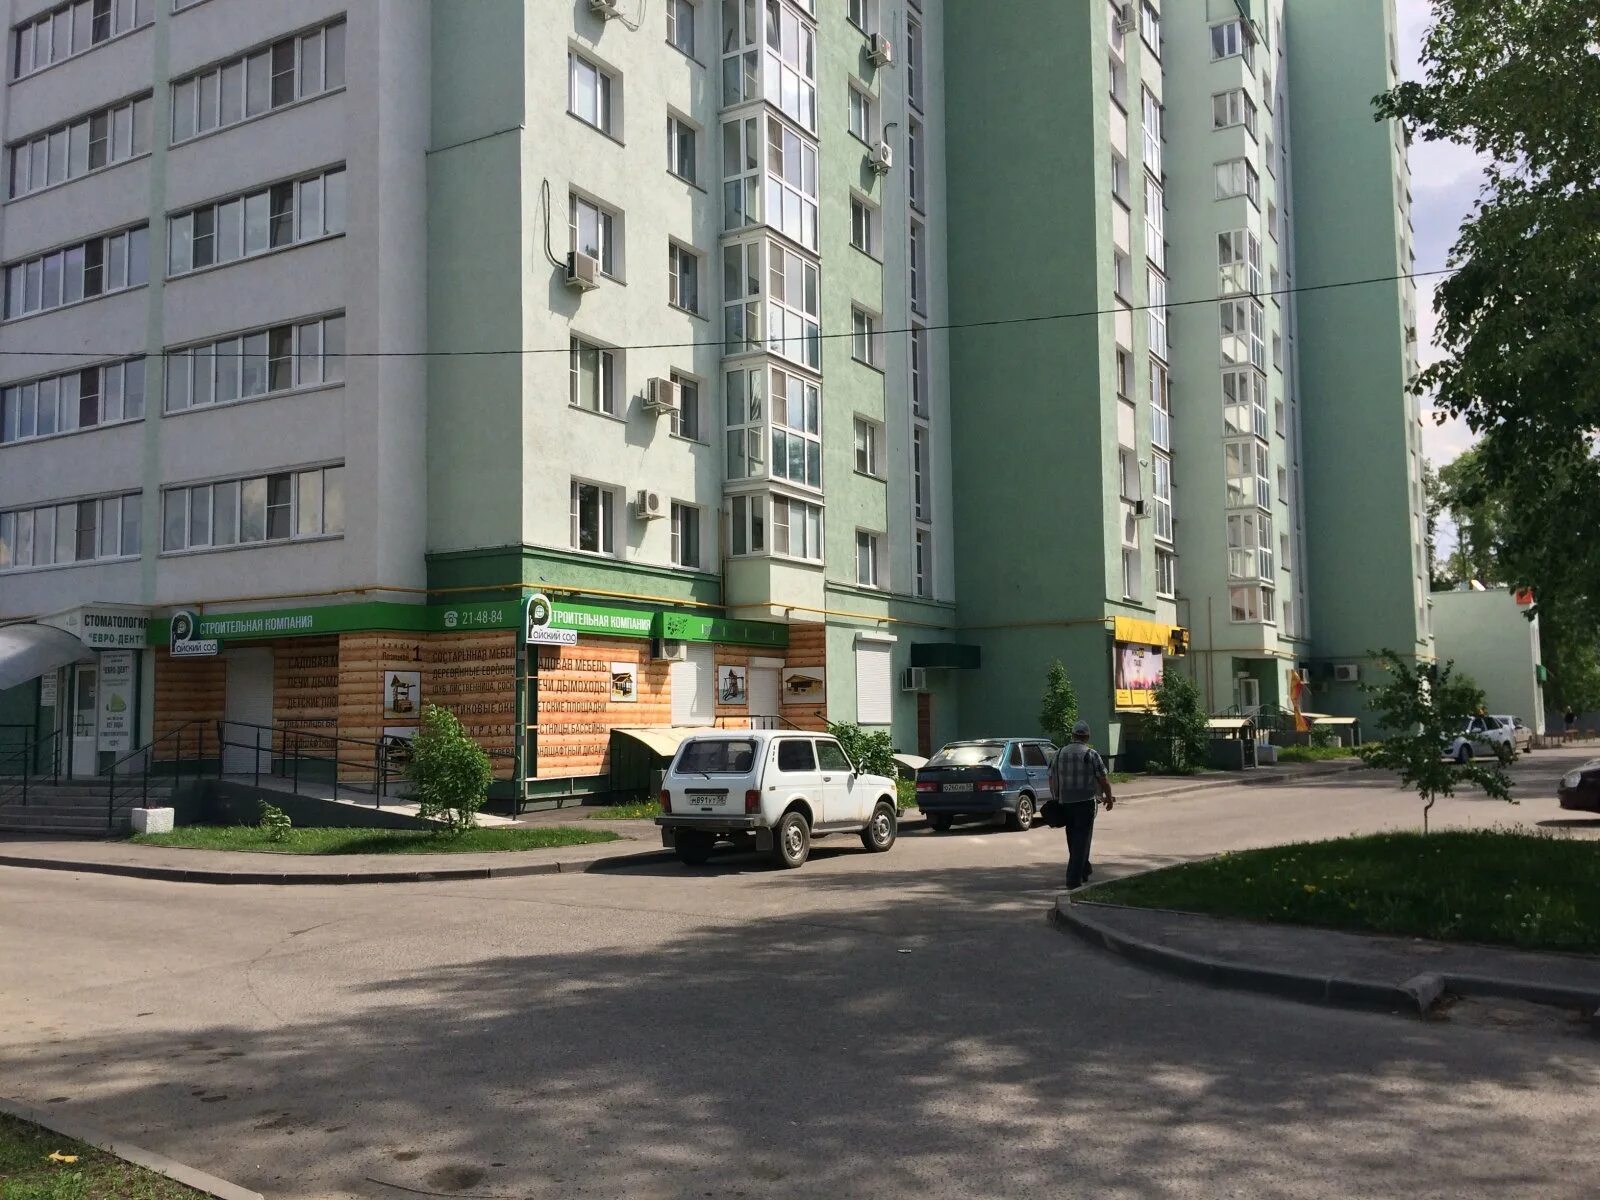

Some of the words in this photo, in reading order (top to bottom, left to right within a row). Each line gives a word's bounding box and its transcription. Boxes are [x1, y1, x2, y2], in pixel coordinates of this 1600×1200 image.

[200, 619, 263, 635] СТРОИТЕЛЬНАЯ
[265, 615, 313, 631] КОМПАНИЯ
[462, 609, 503, 625] 21-48-84
[551, 609, 609, 628] ТРОИТЕЛЬНАЯ
[610, 616, 651, 631] КОМПАНИЯ
[538, 657, 573, 671] АДОВАЯ
[575, 658, 607, 672] МЕБЕЛЬ
[538, 679, 554, 692] ЕЧИ
[556, 679, 607, 695] ДЫМОХОДЫ
[537, 701, 565, 713] ЕТСКИЕ
[566, 702, 607, 714] ПЛОЩАДКИ
[571, 723, 607, 735] БАССЕЙНЫ
